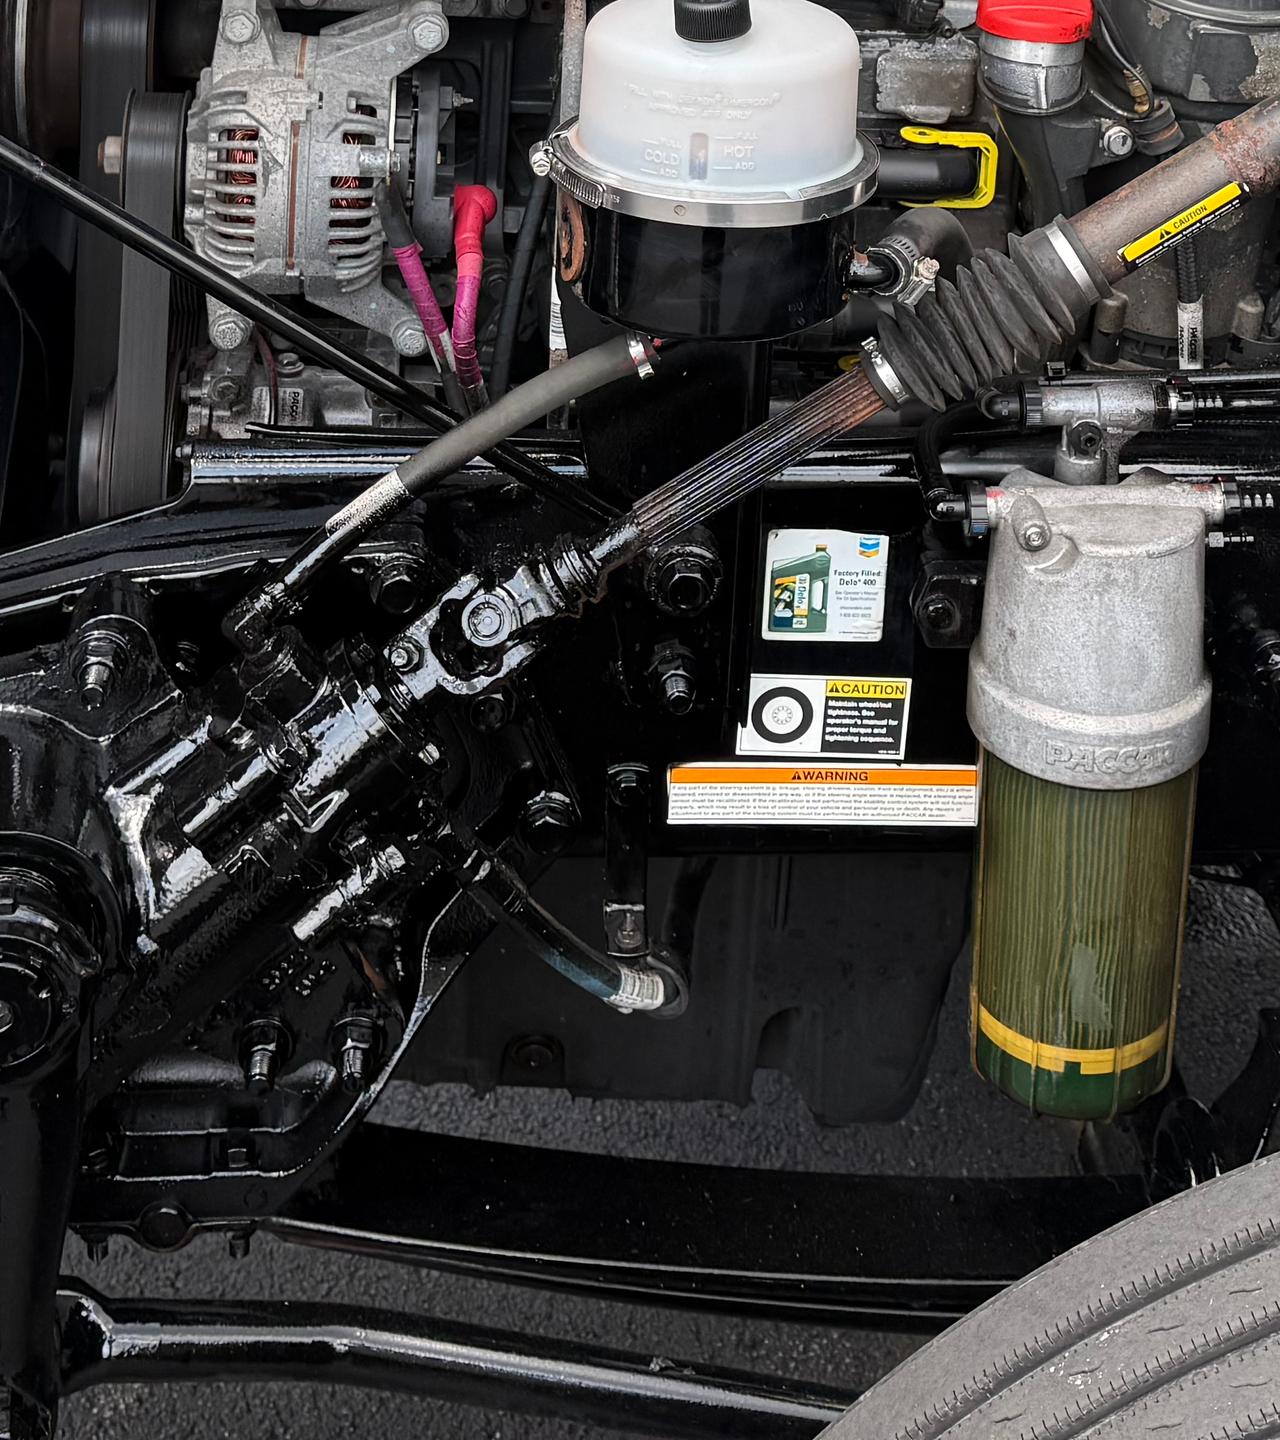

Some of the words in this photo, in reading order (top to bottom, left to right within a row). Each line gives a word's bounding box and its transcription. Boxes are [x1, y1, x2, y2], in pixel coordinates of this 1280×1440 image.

[644, 148, 680, 165] COLD
[723, 146, 754, 158] HOT
[1173, 204, 1208, 229] CAUTION
[841, 684, 904, 695] CAUTION
[1044, 740, 1174, 774] PACCAR
[803, 771, 868, 781] WARNING
